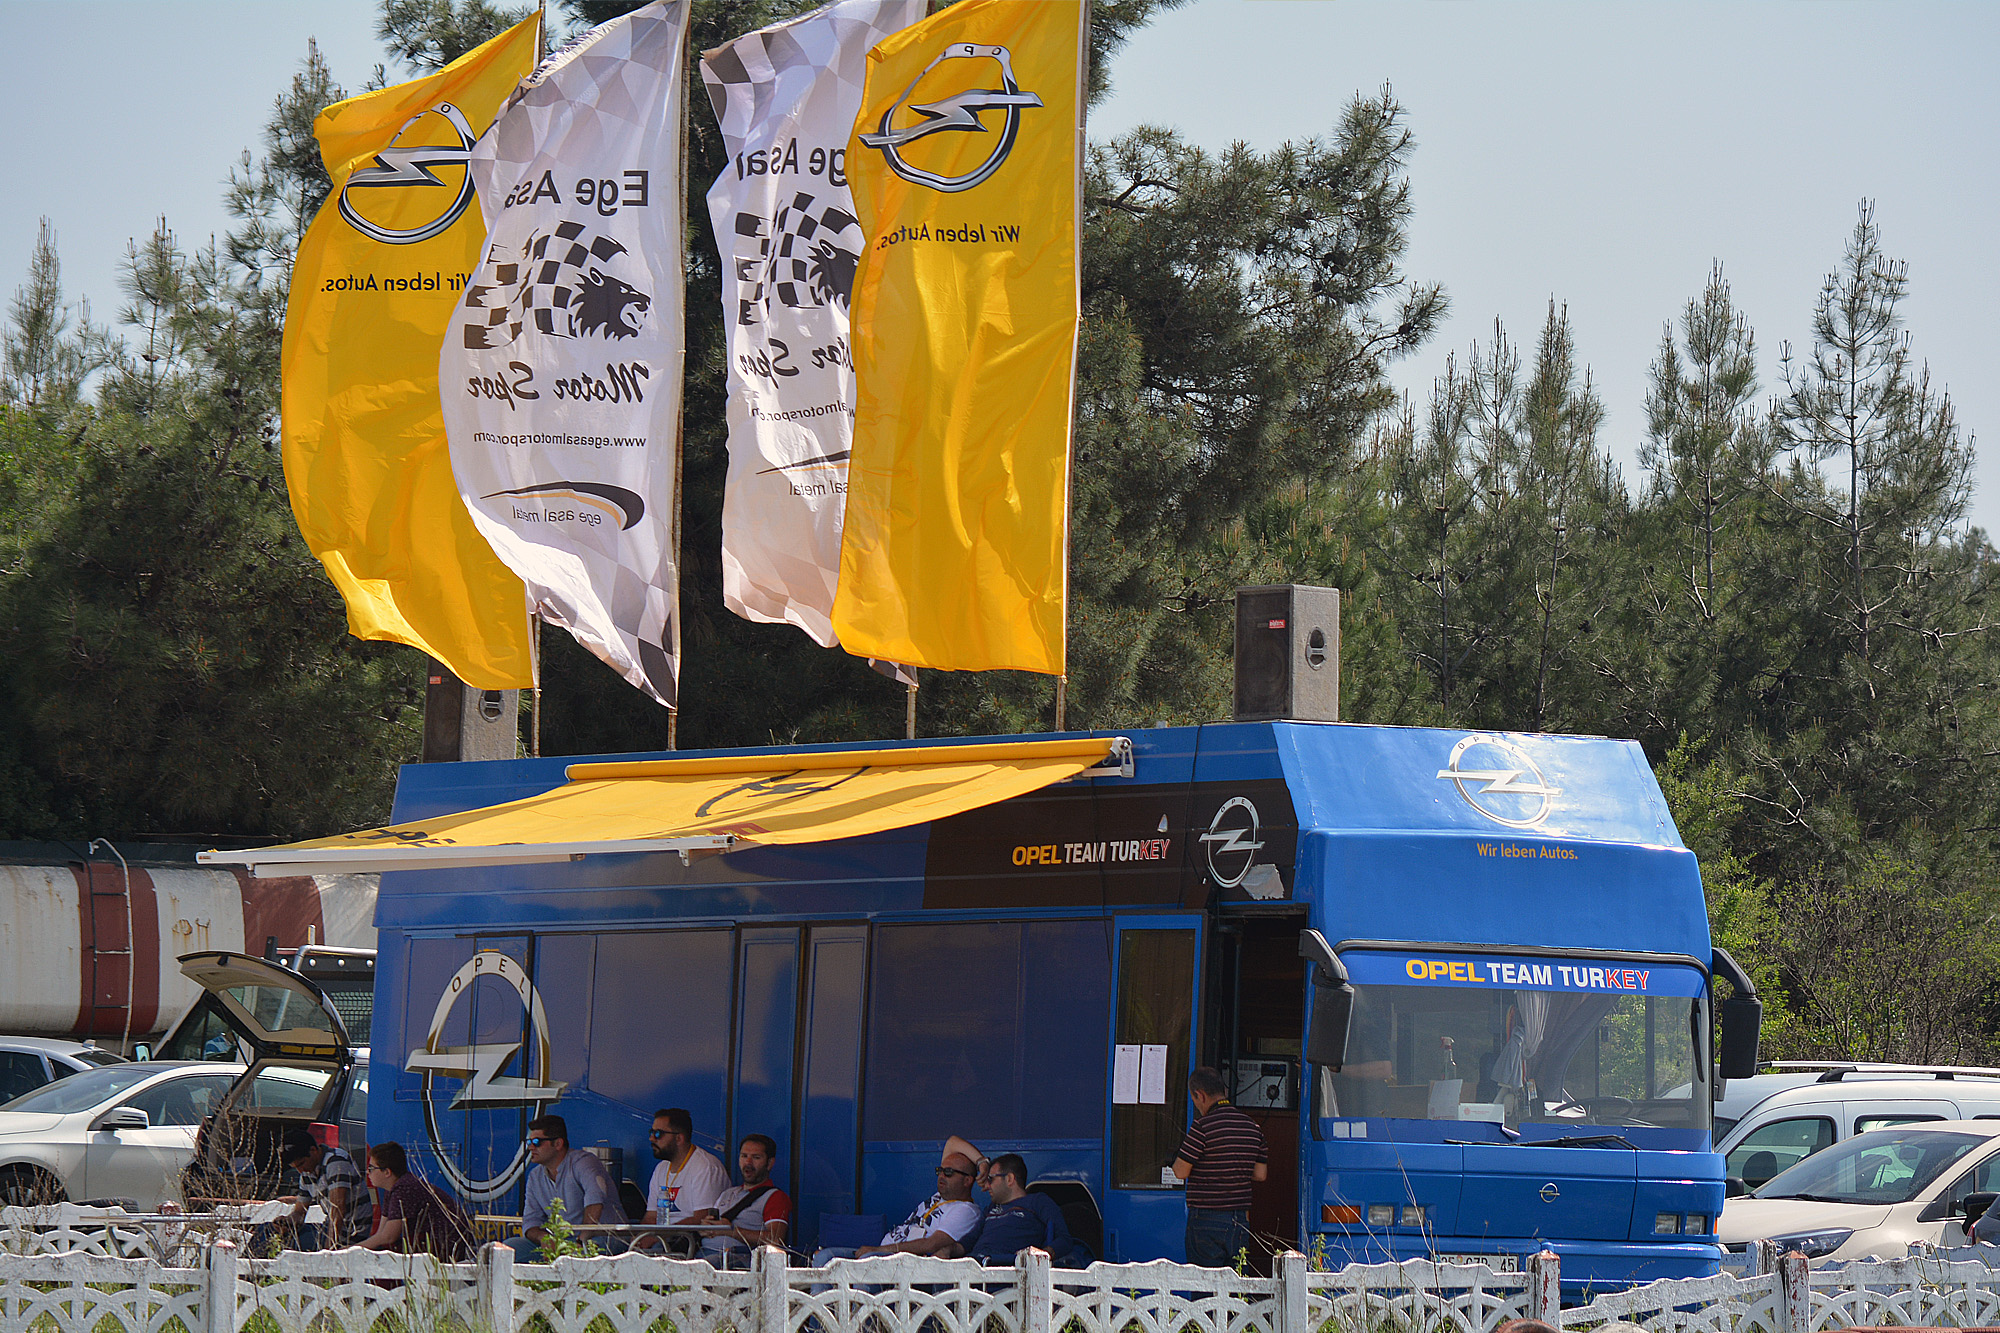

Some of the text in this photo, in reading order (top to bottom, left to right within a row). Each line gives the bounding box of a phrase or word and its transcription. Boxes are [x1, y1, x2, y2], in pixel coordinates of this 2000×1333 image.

[1457, 736, 1517, 753] OPEL
[1221, 798, 1253, 812] OPEL
[1011, 838, 1171, 866] OPEL TEAM TURKEY
[1476, 842, 1579, 860] Wir leben Autos.
[451, 957, 525, 994] OPEL
[1405, 958, 1650, 990] OPEL TEAM TURKEY
